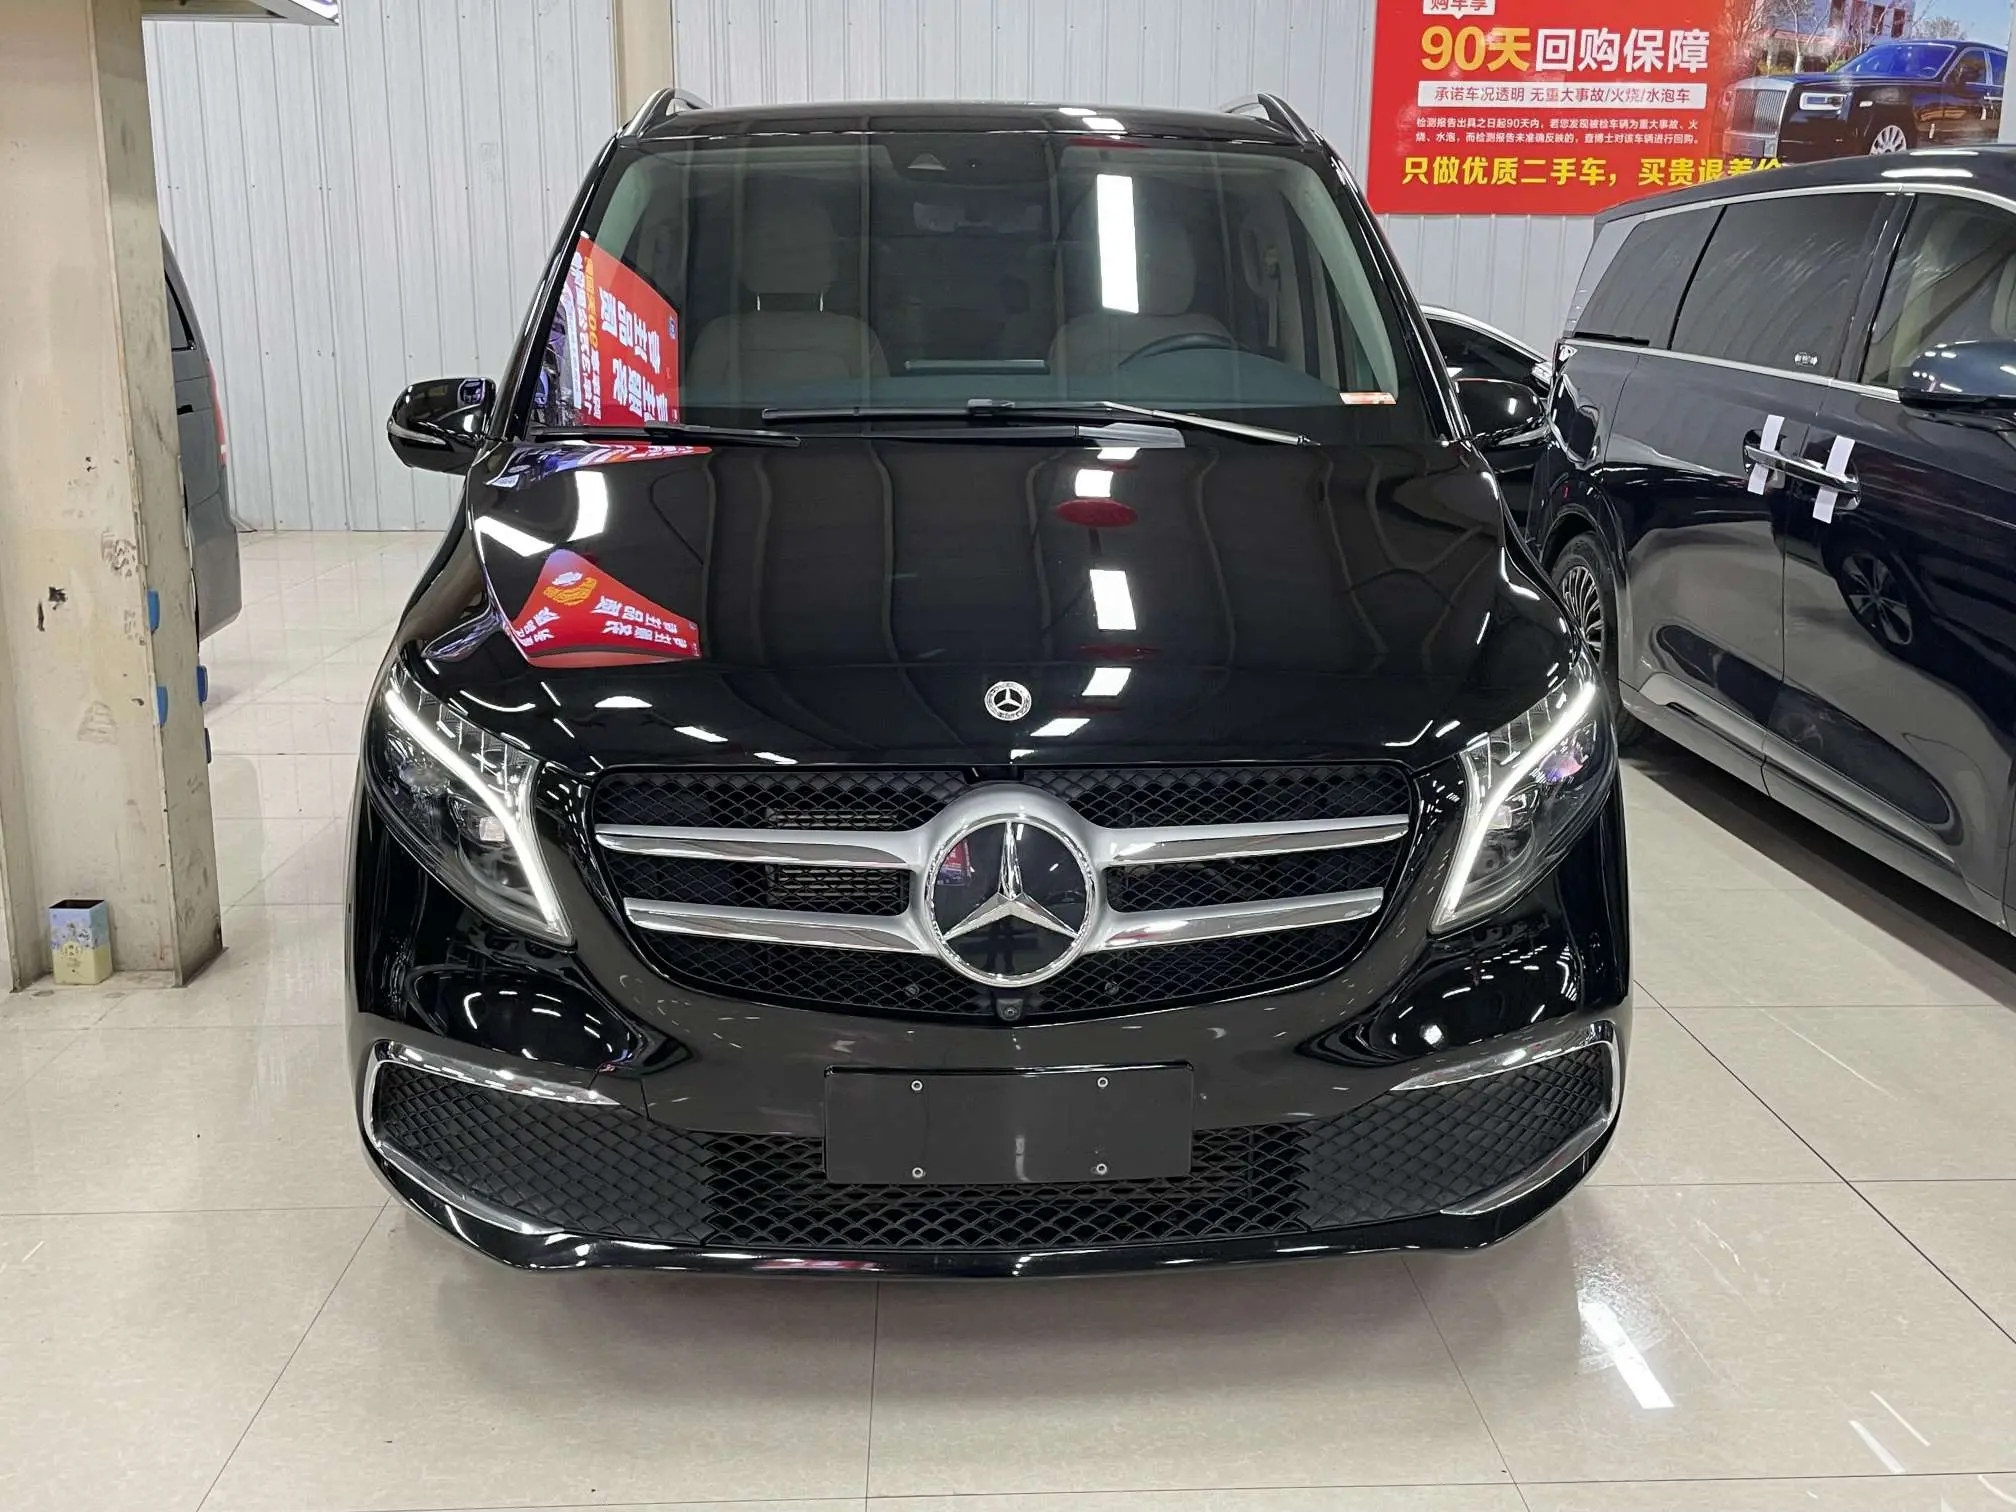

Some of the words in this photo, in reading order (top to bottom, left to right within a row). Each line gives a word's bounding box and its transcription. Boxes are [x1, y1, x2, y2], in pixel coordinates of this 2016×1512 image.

[1421, 25, 1710, 73] 90天回购保障
[1434, 86, 1525, 102] 承诺车况透明
[1530, 87, 1690, 103] 无重大事故/火烧/水泡车
